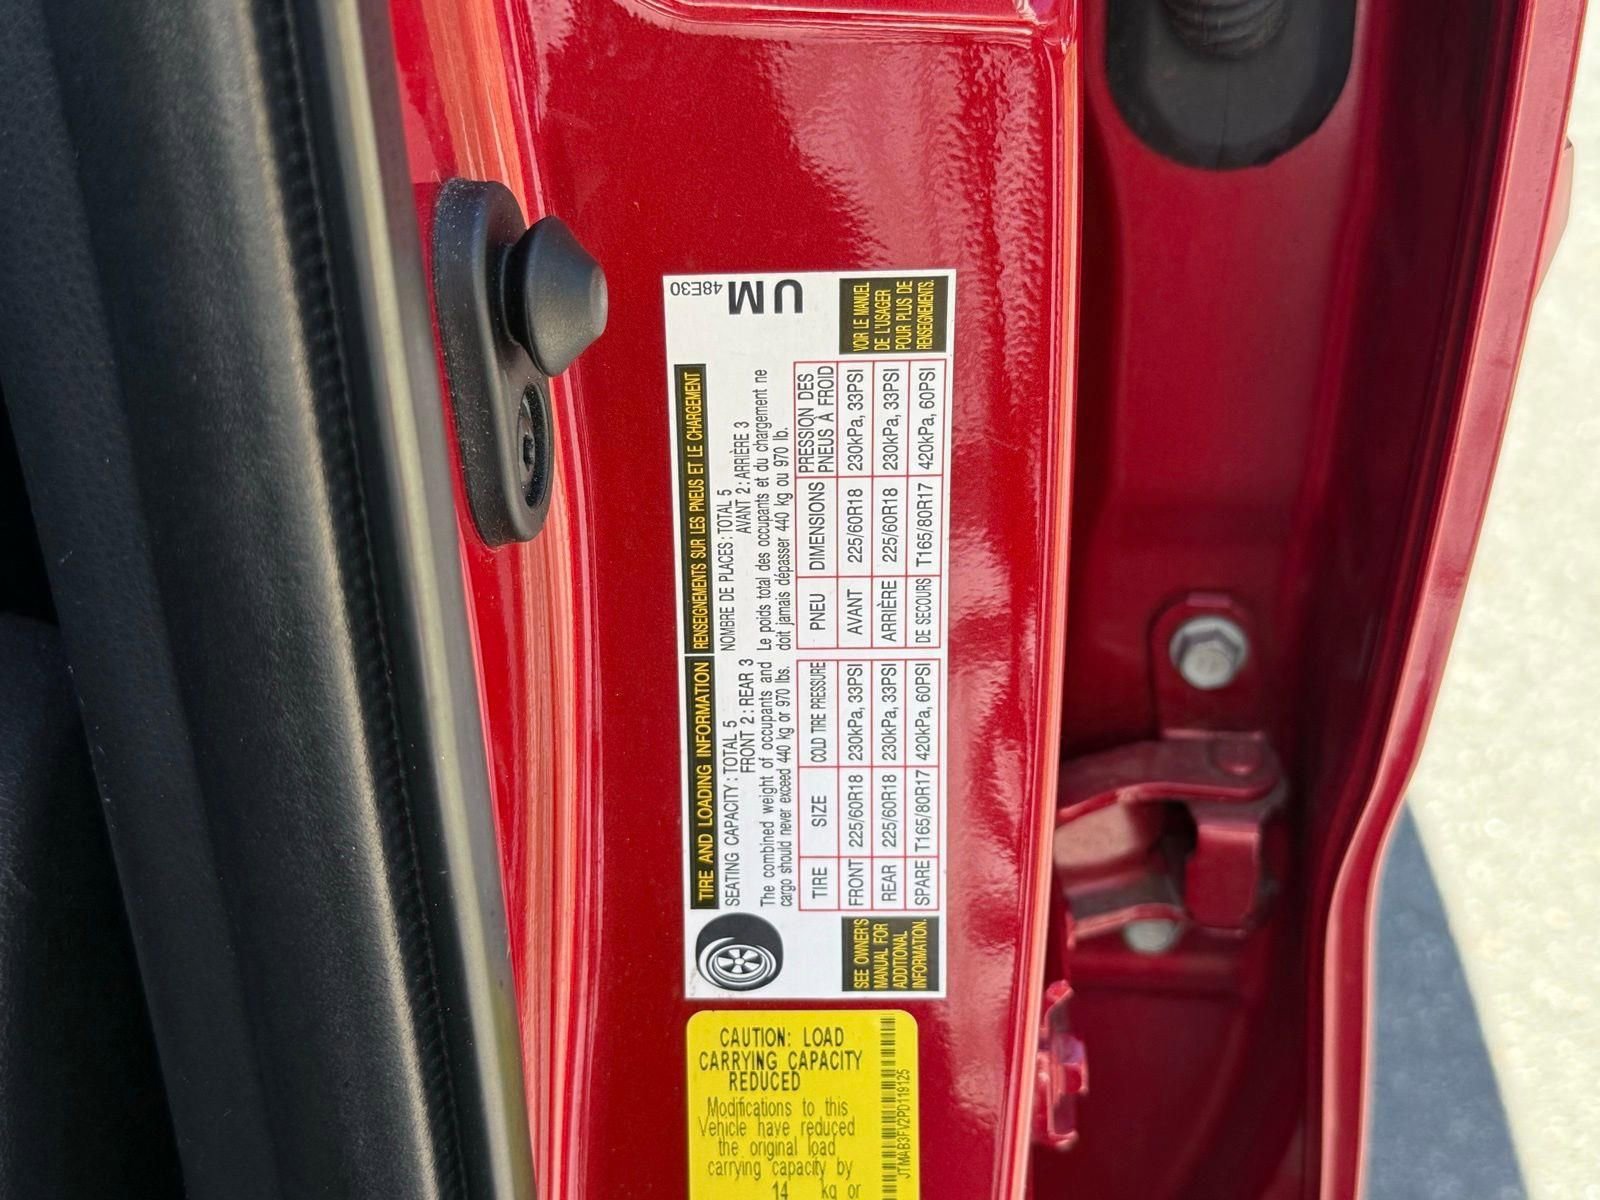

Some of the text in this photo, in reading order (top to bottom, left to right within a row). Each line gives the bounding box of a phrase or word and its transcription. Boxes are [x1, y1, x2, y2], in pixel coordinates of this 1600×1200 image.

[670, 279, 803, 315] UM 48E30
[853, 282, 870, 351] VOIR LE MANUEL
[875, 290, 891, 350] DE L'USAGER
[896, 281, 912, 349] POUR PLUS DE
[917, 280, 934, 349] RENSEIGNEMENTS.
[798, 373, 814, 472] PRESSION DES
[813, 366, 834, 472] PNEUS À FROID
[847, 370, 865, 471] 230kPa, 33PSI
[883, 369, 901, 470] 230kPa, 33PSI
[918, 368, 936, 470] 420kPa, 60PSI
[684, 372, 708, 649] RENSEIGNEMENTS SUR LES PNEUS ET LE CHARGEMENT
[736, 499, 751, 534] AVANT
[753, 370, 774, 650] Le poids total des occupants et du chargement ne
[773, 427, 794, 650] doit jamais dépasser 440 kg ou 970 lb.
[809, 482, 825, 570] DIMENSIONS
[847, 489, 864, 563] 225/60R18
[882, 488, 898, 562] 225/60R18
[916, 483, 933, 567] T165/80R17
[719, 587, 734, 601] DE
[810, 594, 825, 630] PNEU
[847, 589, 863, 635] AVANT
[877, 580, 897, 642] ARRIÈRE
[916, 578, 931, 643] DE SECOURS
[720, 607, 735, 651] NOMBRE
[739, 673, 754, 705] REAR
[810, 662, 826, 762] COLD TIRE PRESSURE
[847, 664, 865, 760] 230kPa, 33PSI
[881, 663, 899, 760] 230kPa, 33PSI
[915, 663, 932, 760] 420kPa, 60PSI
[694, 662, 714, 900] TIRE AND LOADING INFORMATION
[740, 731, 755, 773] FRONT
[757, 662, 777, 906] The combined weight of occupants and
[775, 666, 796, 906] cargo should never exceed 440 kg or 970 lbs.
[812, 795, 827, 827] SIZE
[848, 775, 864, 847] 225/60R18
[882, 775, 899, 847] 225/60R18
[915, 770, 932, 852] T165/80R17
[725, 853, 739, 906] SEATING
[813, 867, 827, 899] TIRE
[849, 859, 863, 906] FRONT
[882, 865, 896, 901] REAR
[915, 860, 930, 905] SPARE
[854, 919, 869, 988] SEE OWNER'S
[873, 924, 888, 988] MANUAL FOR
[893, 931, 908, 988] ADDITIONAL
[912, 919, 927, 988] INFORMATION.
[700, 1050, 862, 1071] CARRYING CAPACITY
[720, 1027, 844, 1047] CAUTION: LOAD
[708, 1097, 848, 1116] Modifications to this
[729, 1071, 800, 1091] REDUCED
[698, 1117, 855, 1136] Vehicle have reduced
[719, 1137, 835, 1160] the original load
[708, 1159, 853, 1180] carrying capacity by
[772, 1181, 788, 1200] 14
[848, 1184, 861, 1199] or
